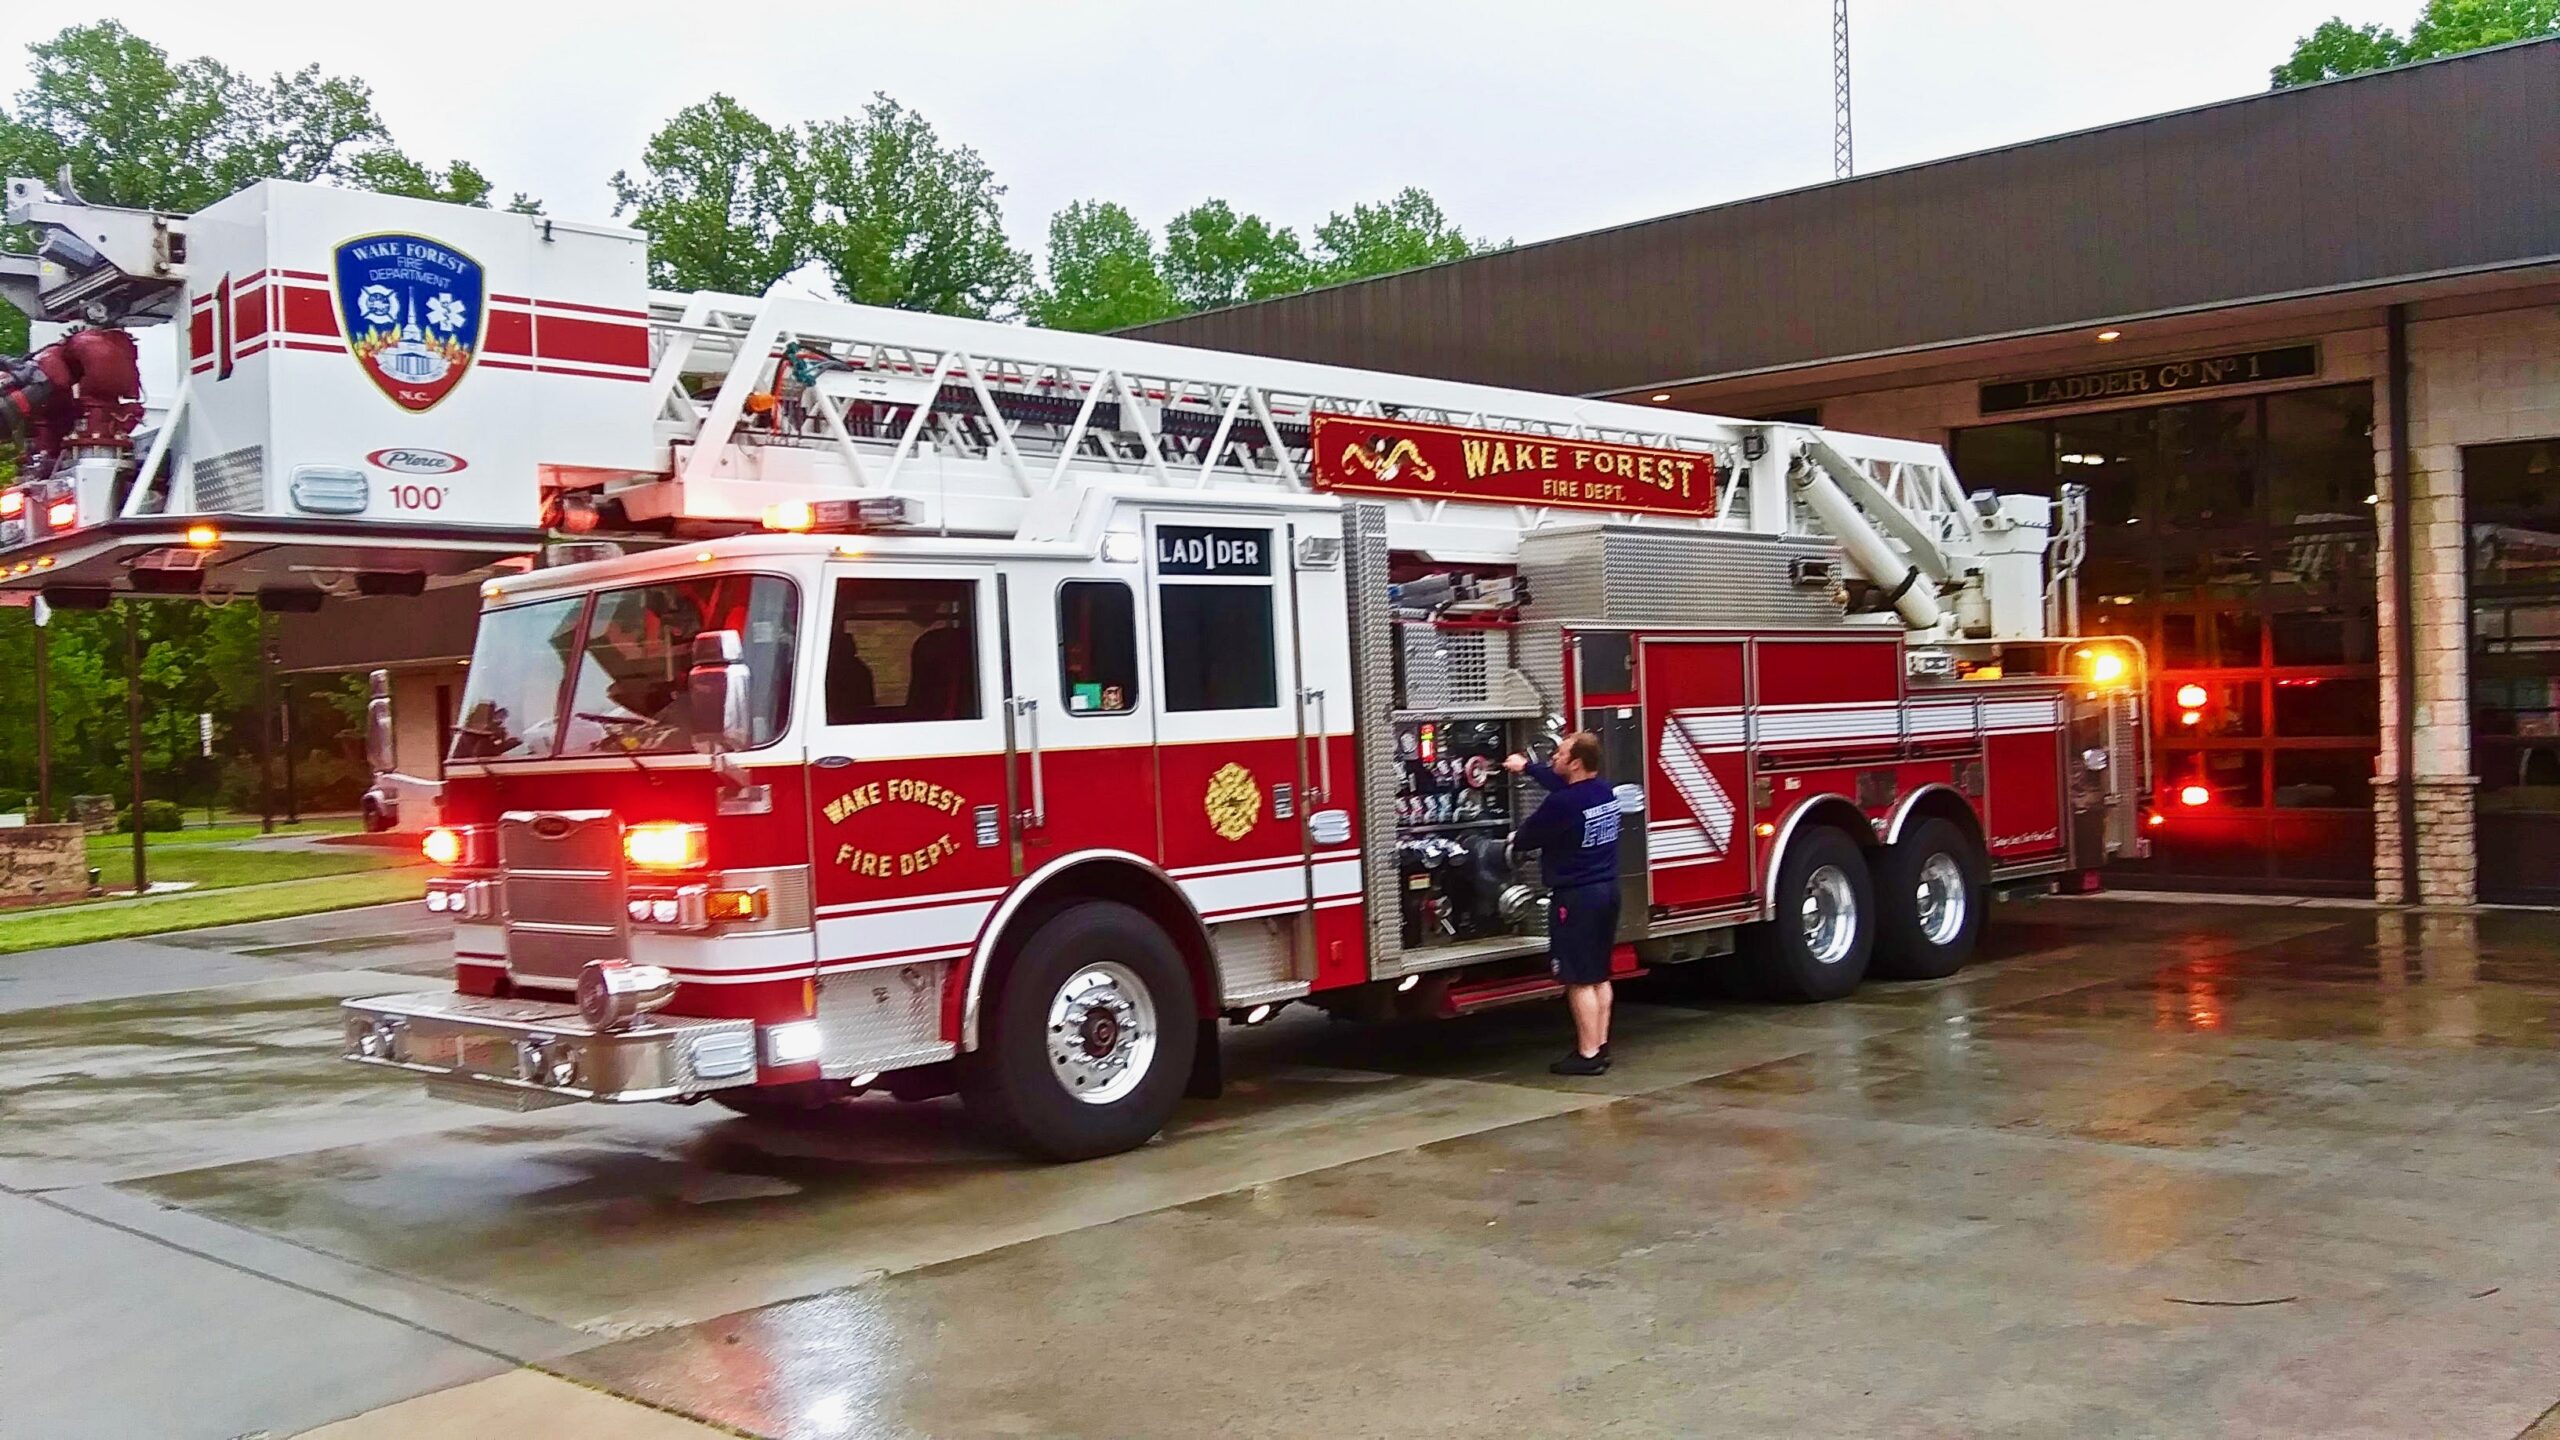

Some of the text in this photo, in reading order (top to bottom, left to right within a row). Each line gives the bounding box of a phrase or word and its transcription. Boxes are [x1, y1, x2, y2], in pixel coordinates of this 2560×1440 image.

[352, 242, 467, 275] WAKE FOREST
[397, 256, 424, 271] FIRE
[369, 269, 452, 288] DEPARTMENT
[2025, 369, 2149, 404] LADDER
[2248, 355, 2261, 377] 1
[387, 451, 447, 468] Pierce
[1462, 438, 1694, 498] WAKE FOREST
[1542, 479, 1627, 501] FIRE DEPT.
[822, 778, 966, 825] WAKE FOREST
[835, 833, 961, 877] FIRE DEPT.
